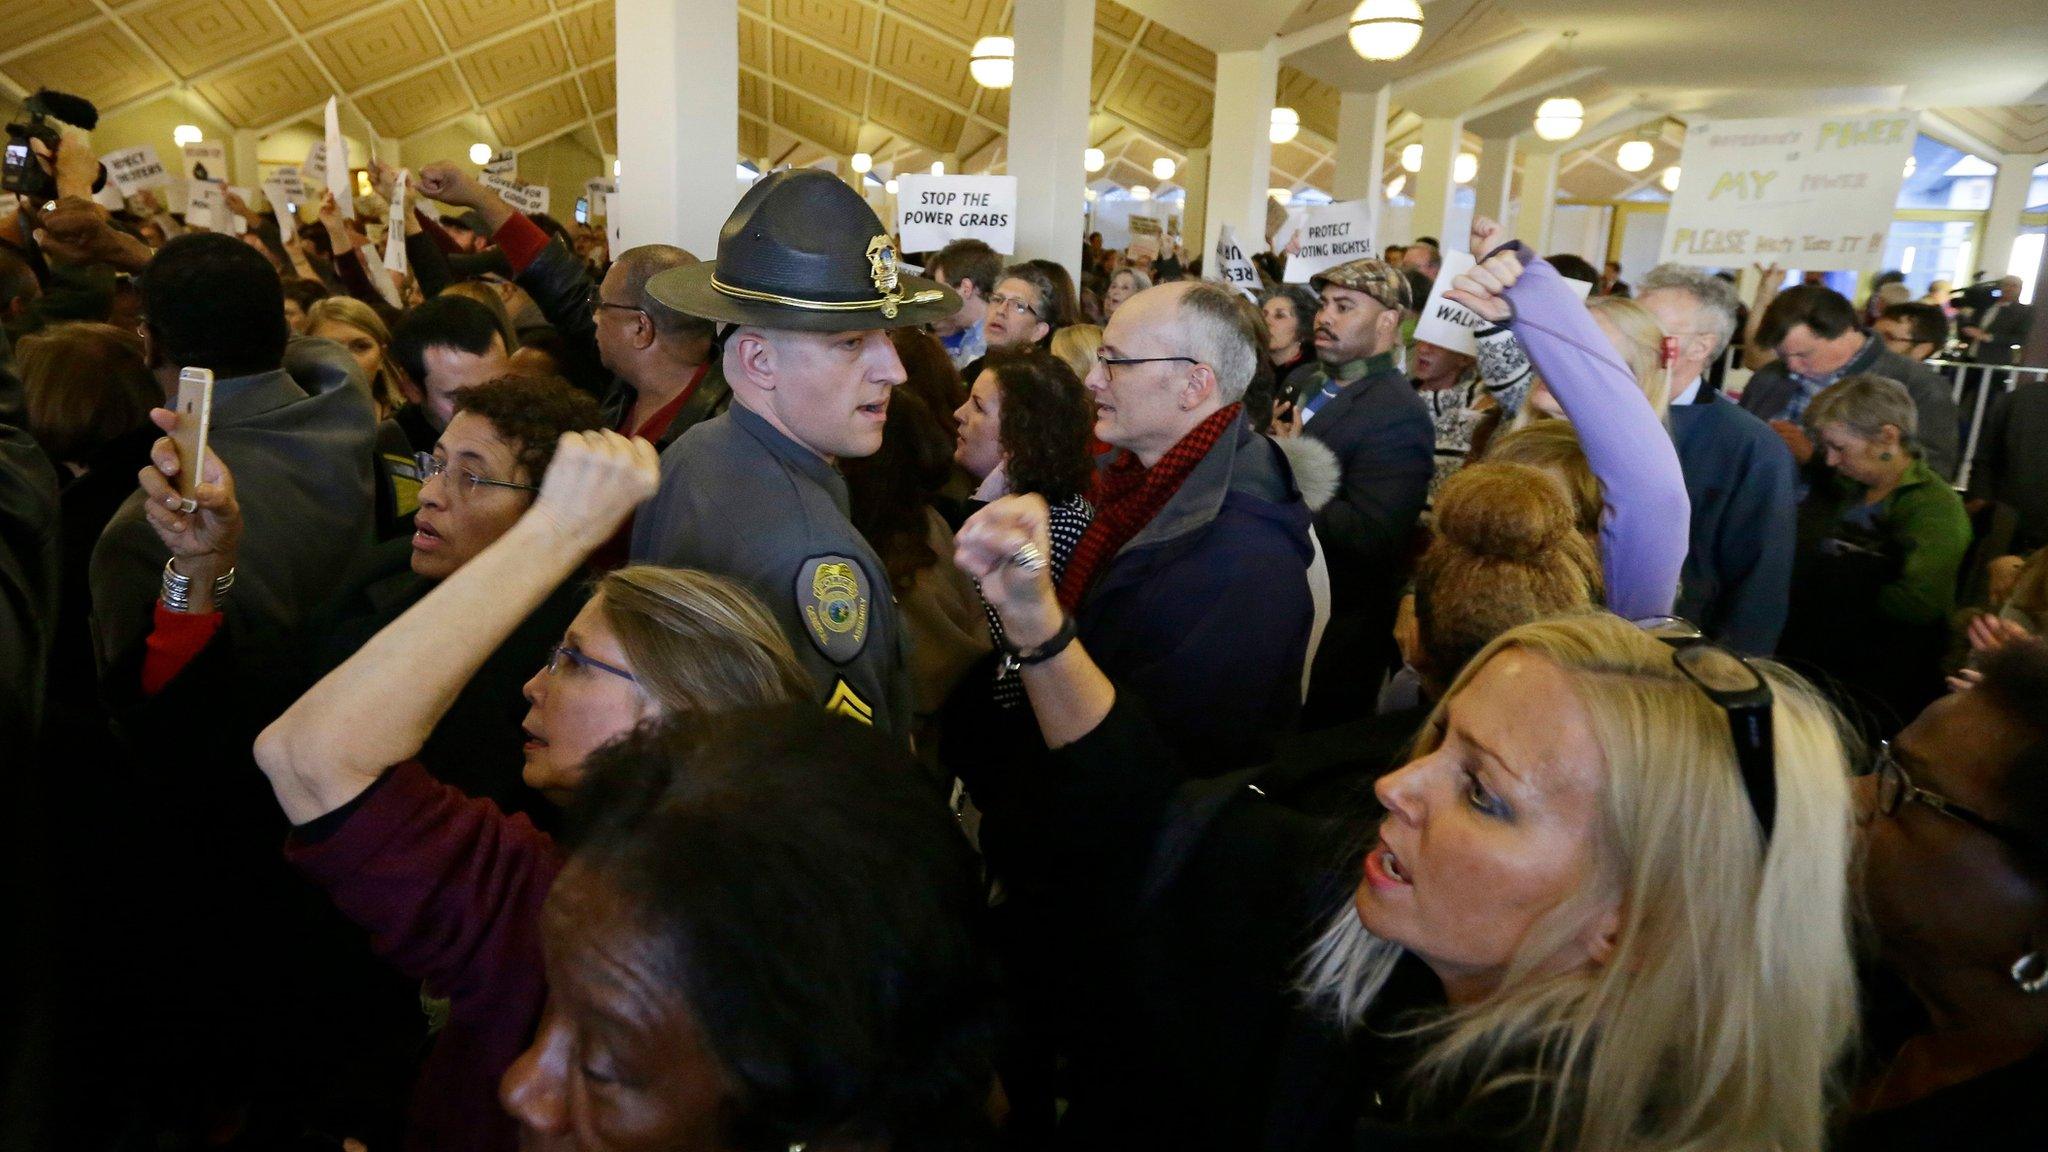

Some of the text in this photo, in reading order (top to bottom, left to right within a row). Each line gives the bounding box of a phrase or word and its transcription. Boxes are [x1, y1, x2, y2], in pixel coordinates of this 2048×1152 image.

[1708, 170, 1777, 200] MY
[504, 191, 528, 205] GOOD
[921, 191, 991, 207] STOP THE
[904, 211, 1009, 227] POWER GRABS
[1308, 222, 1352, 239] PROTECT
[1332, 239, 1370, 256] RIGHTS!
[1671, 228, 1750, 254] PLEASE
[1222, 265, 1254, 282] RES
